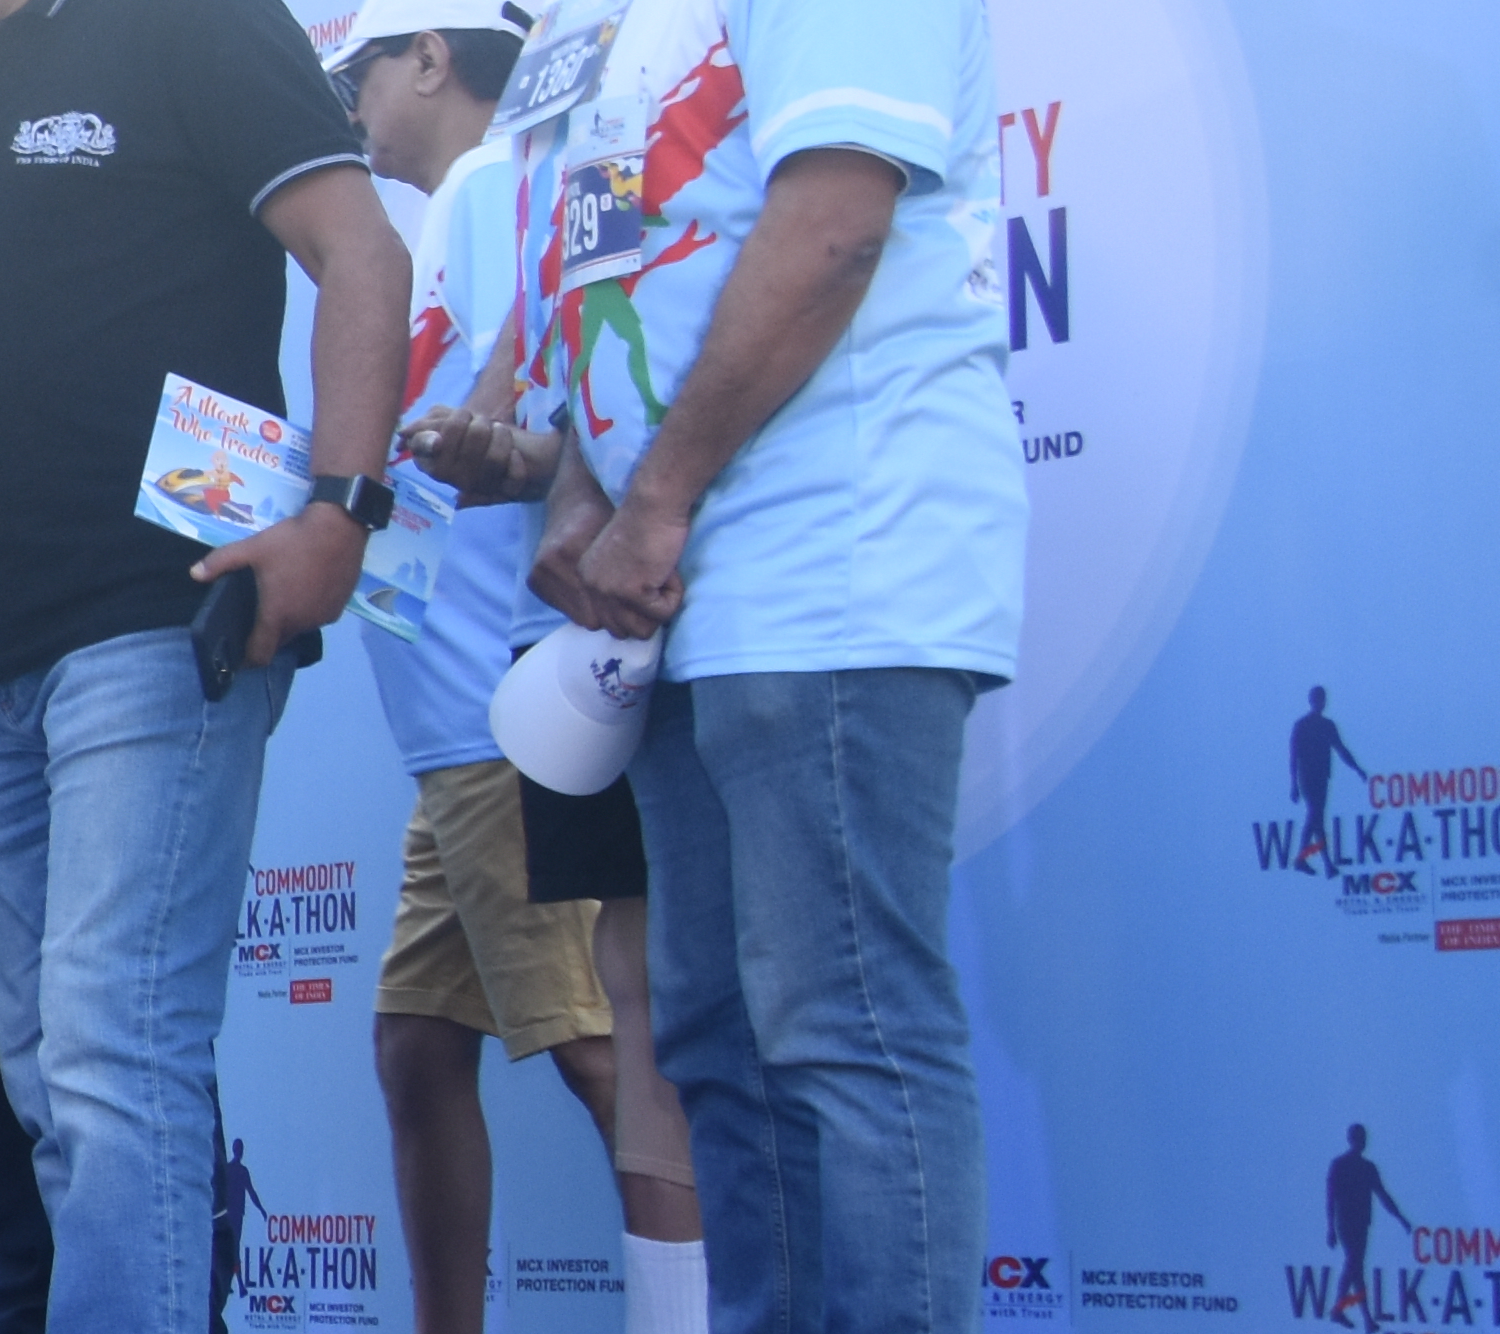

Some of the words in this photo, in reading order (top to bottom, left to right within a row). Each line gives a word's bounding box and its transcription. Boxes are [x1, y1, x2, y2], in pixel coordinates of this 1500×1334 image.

[176, 385, 194, 409] A
[198, 395, 250, 436] Monk
[169, 407, 212, 443] Who
[220, 426, 281, 470] Trades
[1022, 430, 1084, 464] UND
[255, 861, 356, 897] COMMODITY
[1342, 870, 1418, 897] MCX
[238, 943, 282, 963] MCX
[267, 1215, 376, 1244] COMMODITY
[516, 1259, 545, 1273] MCX
[546, 1259, 610, 1274] INVESTOR
[981, 1255, 1051, 1290] CX
[516, 1278, 598, 1293] PROTECTION
[600, 1279, 626, 1294] FUN
[1081, 1269, 1118, 1288] MCX
[1121, 1270, 1205, 1289] INVESTOR
[249, 1294, 296, 1314] MCX
[327, 1303, 365, 1314] INVESTOR
[1081, 1291, 1188, 1311] PROTECTION
[1192, 1295, 1239, 1314] FUND
[309, 1315, 356, 1326] PROTECTION
